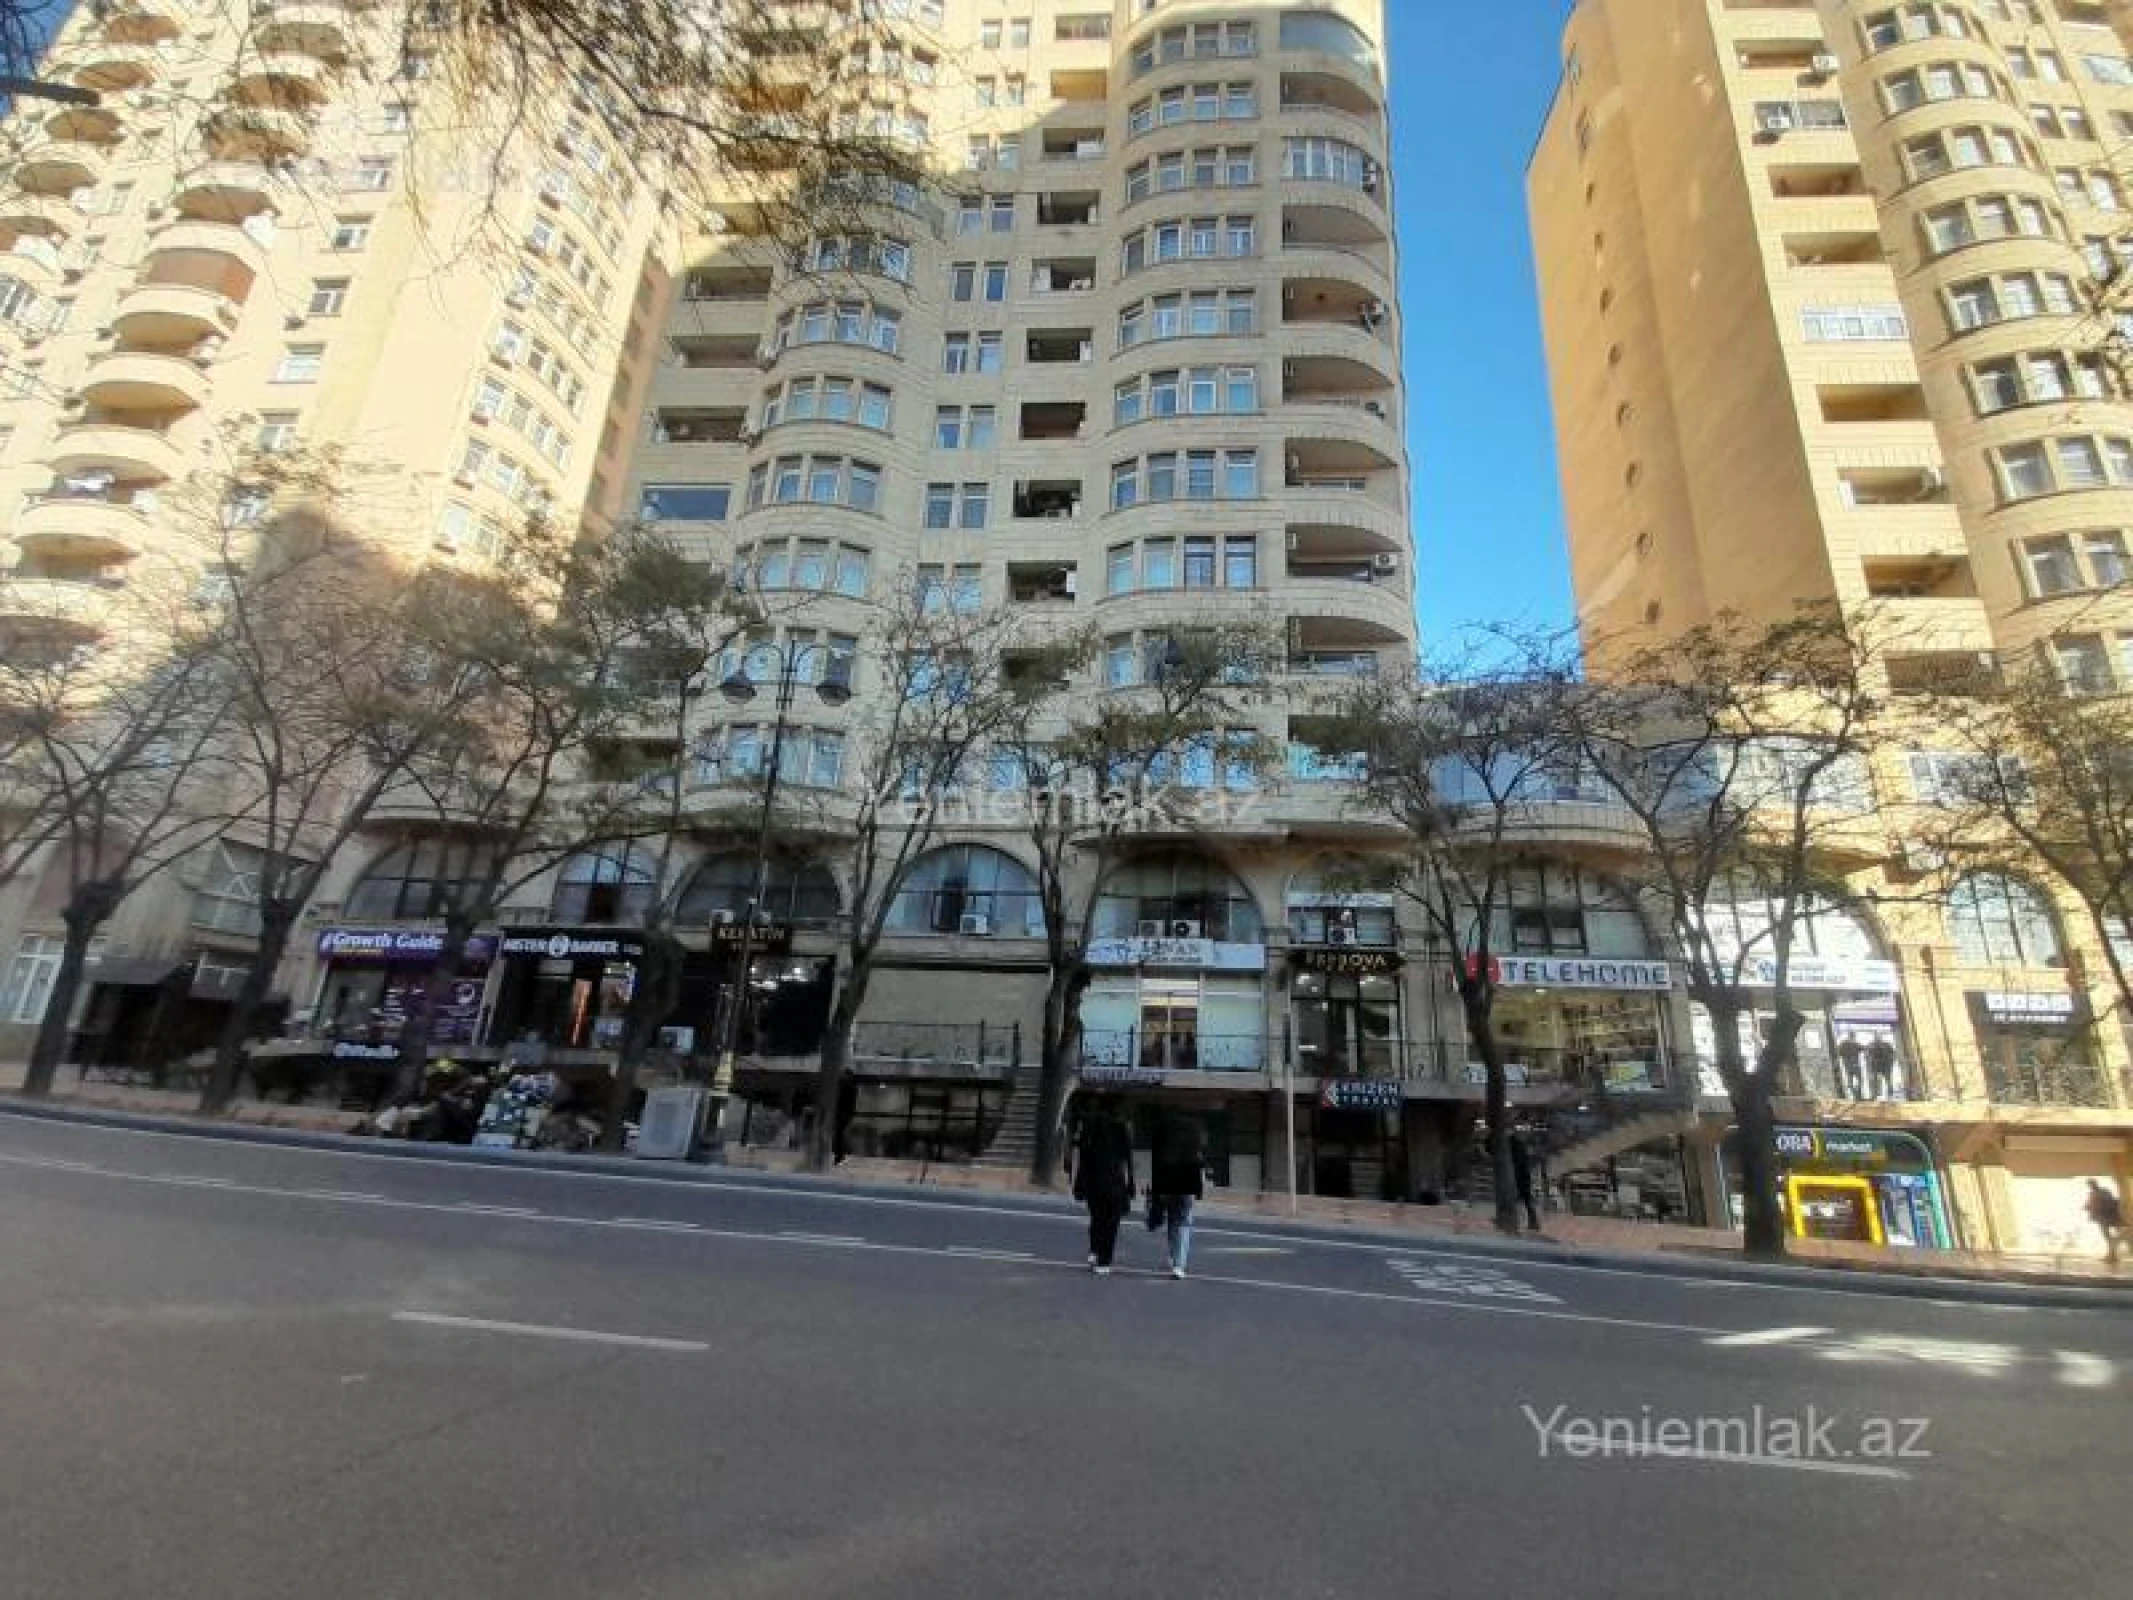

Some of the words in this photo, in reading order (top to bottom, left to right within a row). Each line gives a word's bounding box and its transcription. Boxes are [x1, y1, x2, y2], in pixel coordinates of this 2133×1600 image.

[333, 931, 392, 948] Growth
[397, 933, 443, 949] Guide
[1506, 961, 1668, 985] TELEHOME
